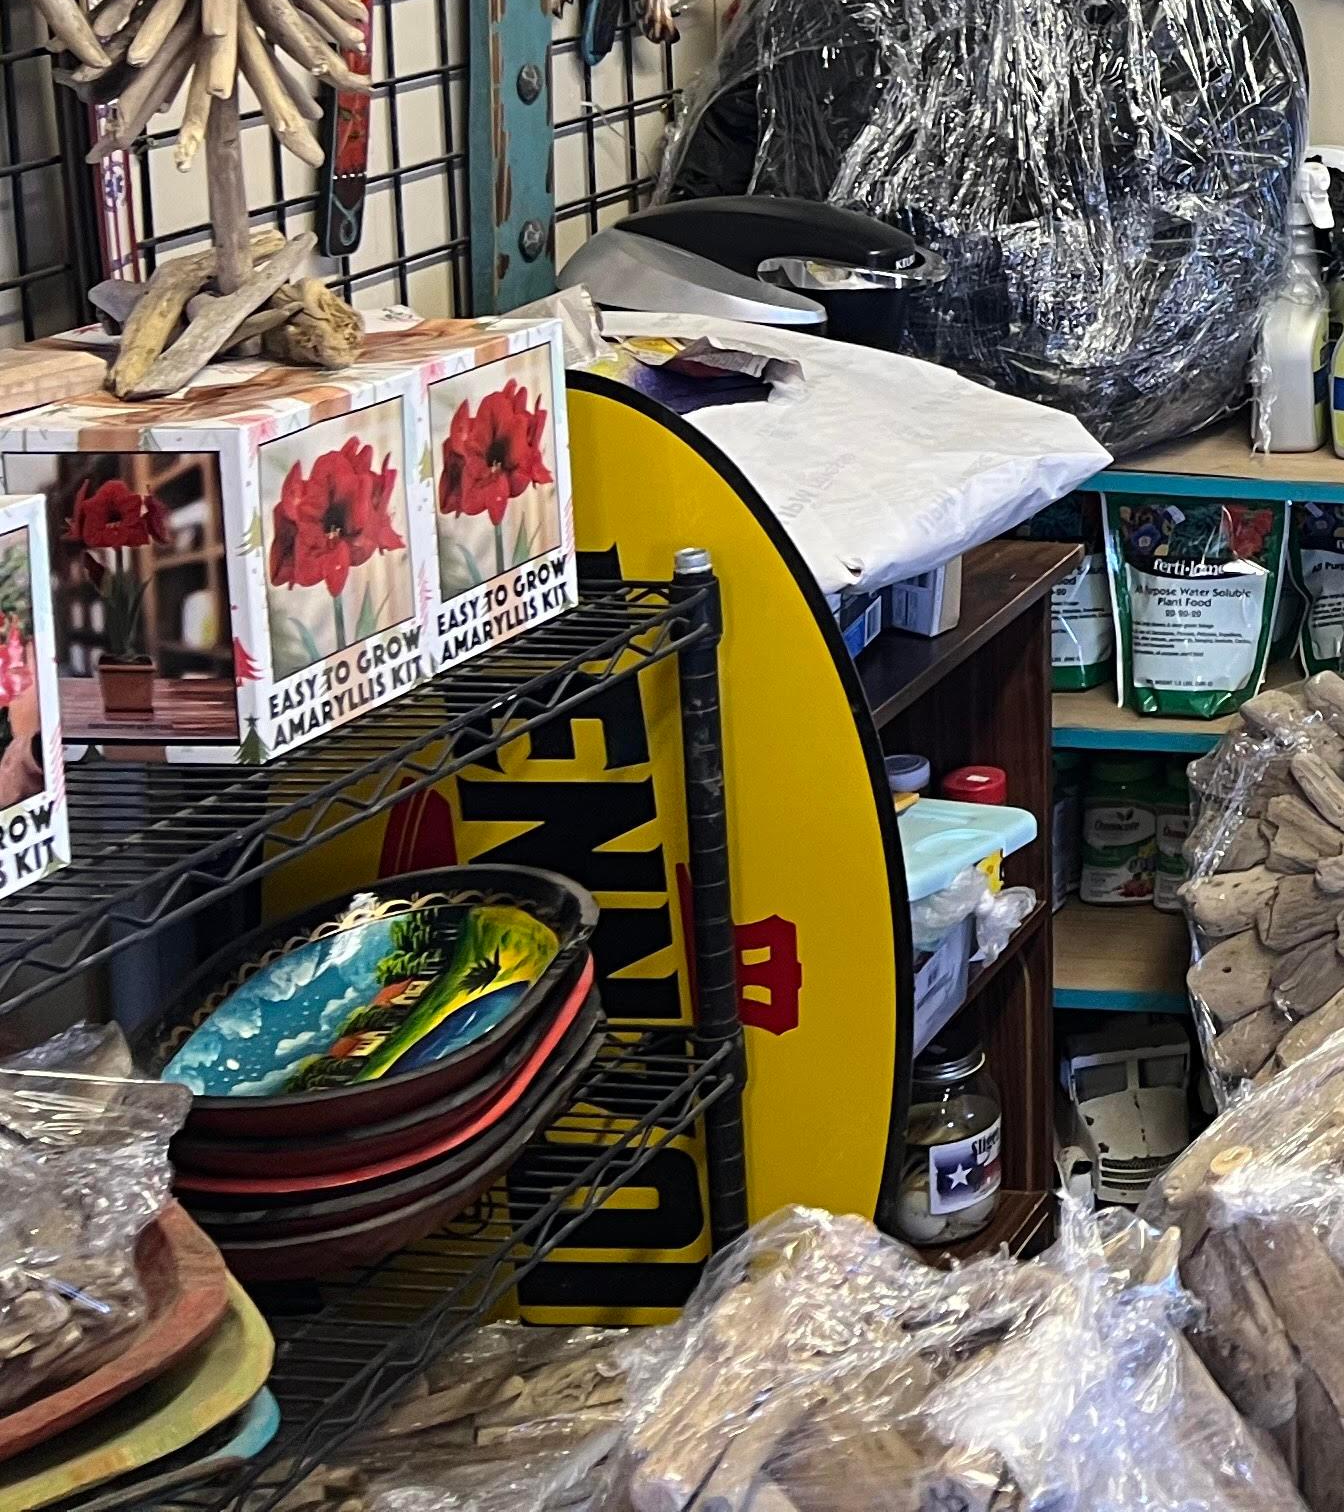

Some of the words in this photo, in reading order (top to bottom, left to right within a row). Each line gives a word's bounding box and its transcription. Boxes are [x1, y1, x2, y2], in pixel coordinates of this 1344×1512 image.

[437, 599, 481, 635] EASY
[481, 583, 509, 616] TO
[513, 554, 567, 599] GROW
[441, 603, 538, 665] AMARYLLIS
[542, 583, 571, 614] KIT
[1157, 597, 1182, 606] Plant
[1185, 598, 1212, 607] Food
[1180, 587, 1210, 597] Water
[268, 677, 318, 722] EASY
[321, 657, 354, 700] TO
[357, 626, 423, 683] GROW
[272, 677, 387, 750] AMARYLLIS
[391, 656, 426, 693] KIT
[14, 837, 56, 879] KIT
